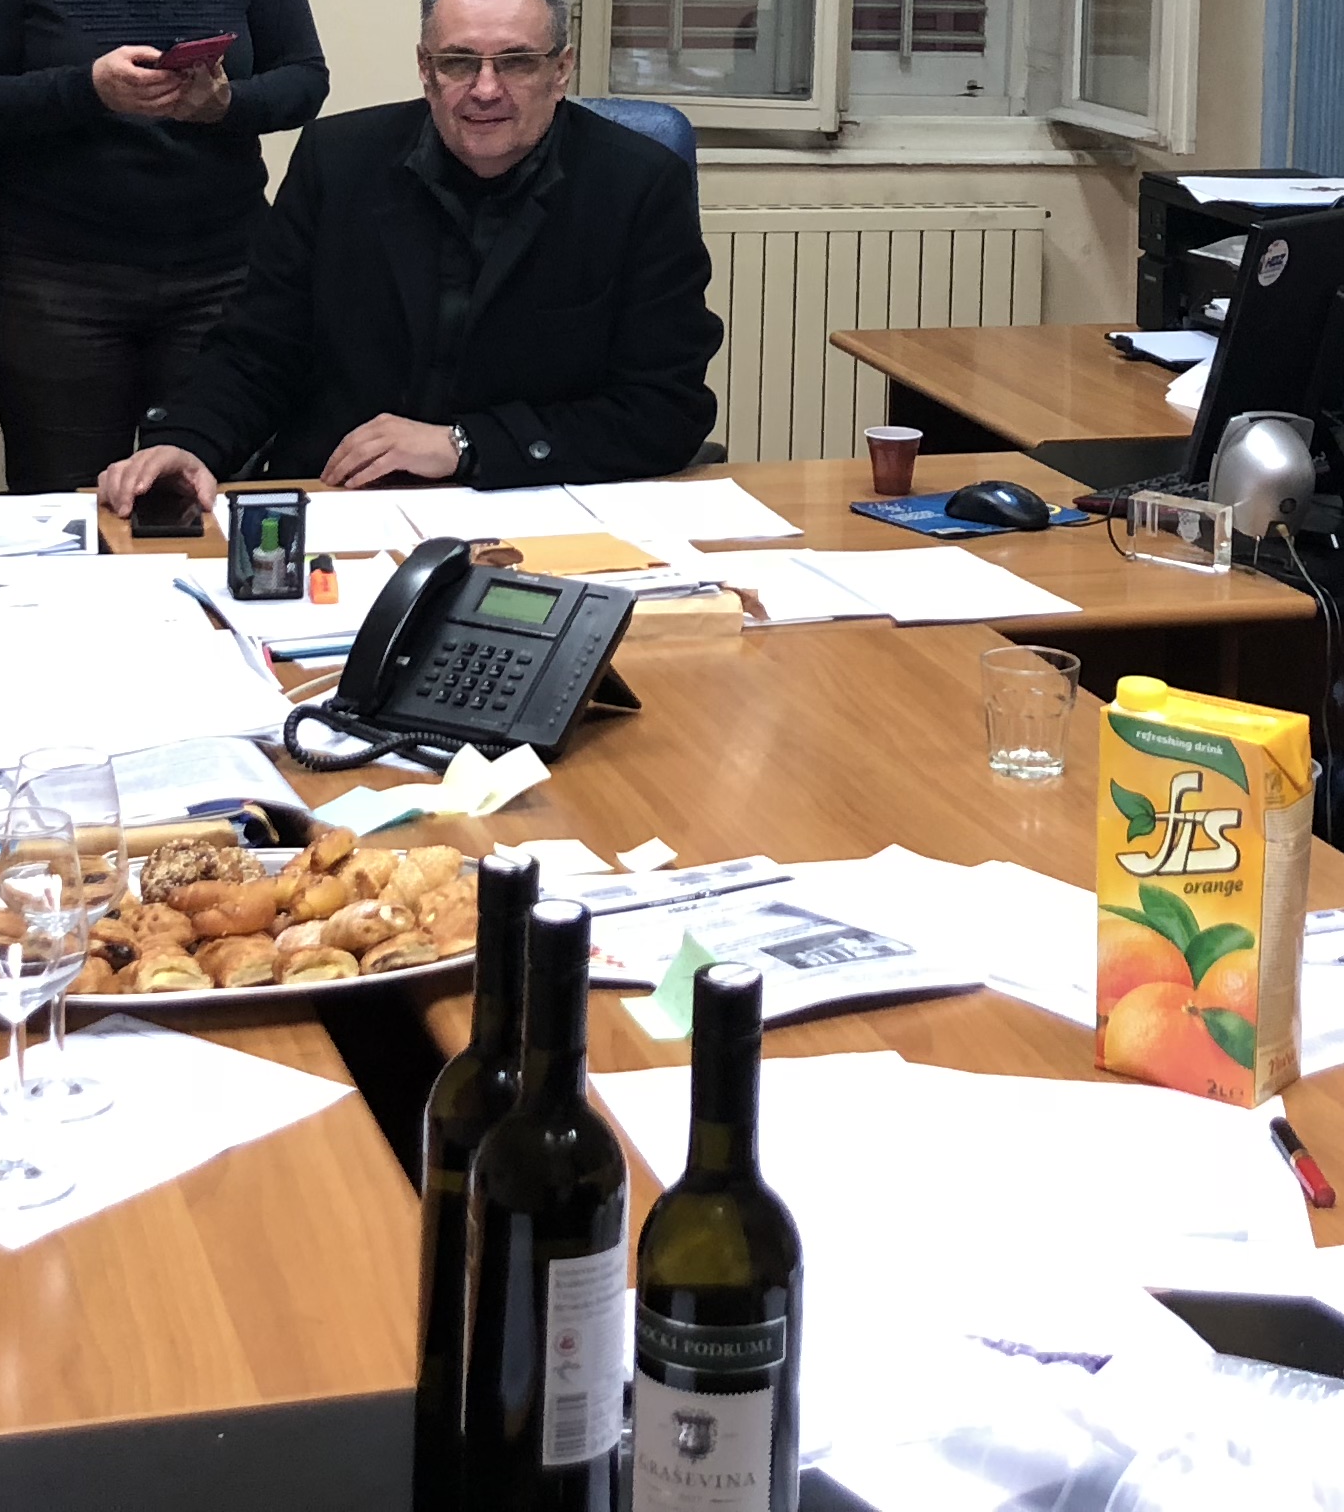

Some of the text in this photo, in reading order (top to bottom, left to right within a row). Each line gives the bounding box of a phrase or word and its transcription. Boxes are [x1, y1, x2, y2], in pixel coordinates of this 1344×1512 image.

[1135, 729, 1224, 756] refreshing drink
[1183, 879, 1244, 897] orange
